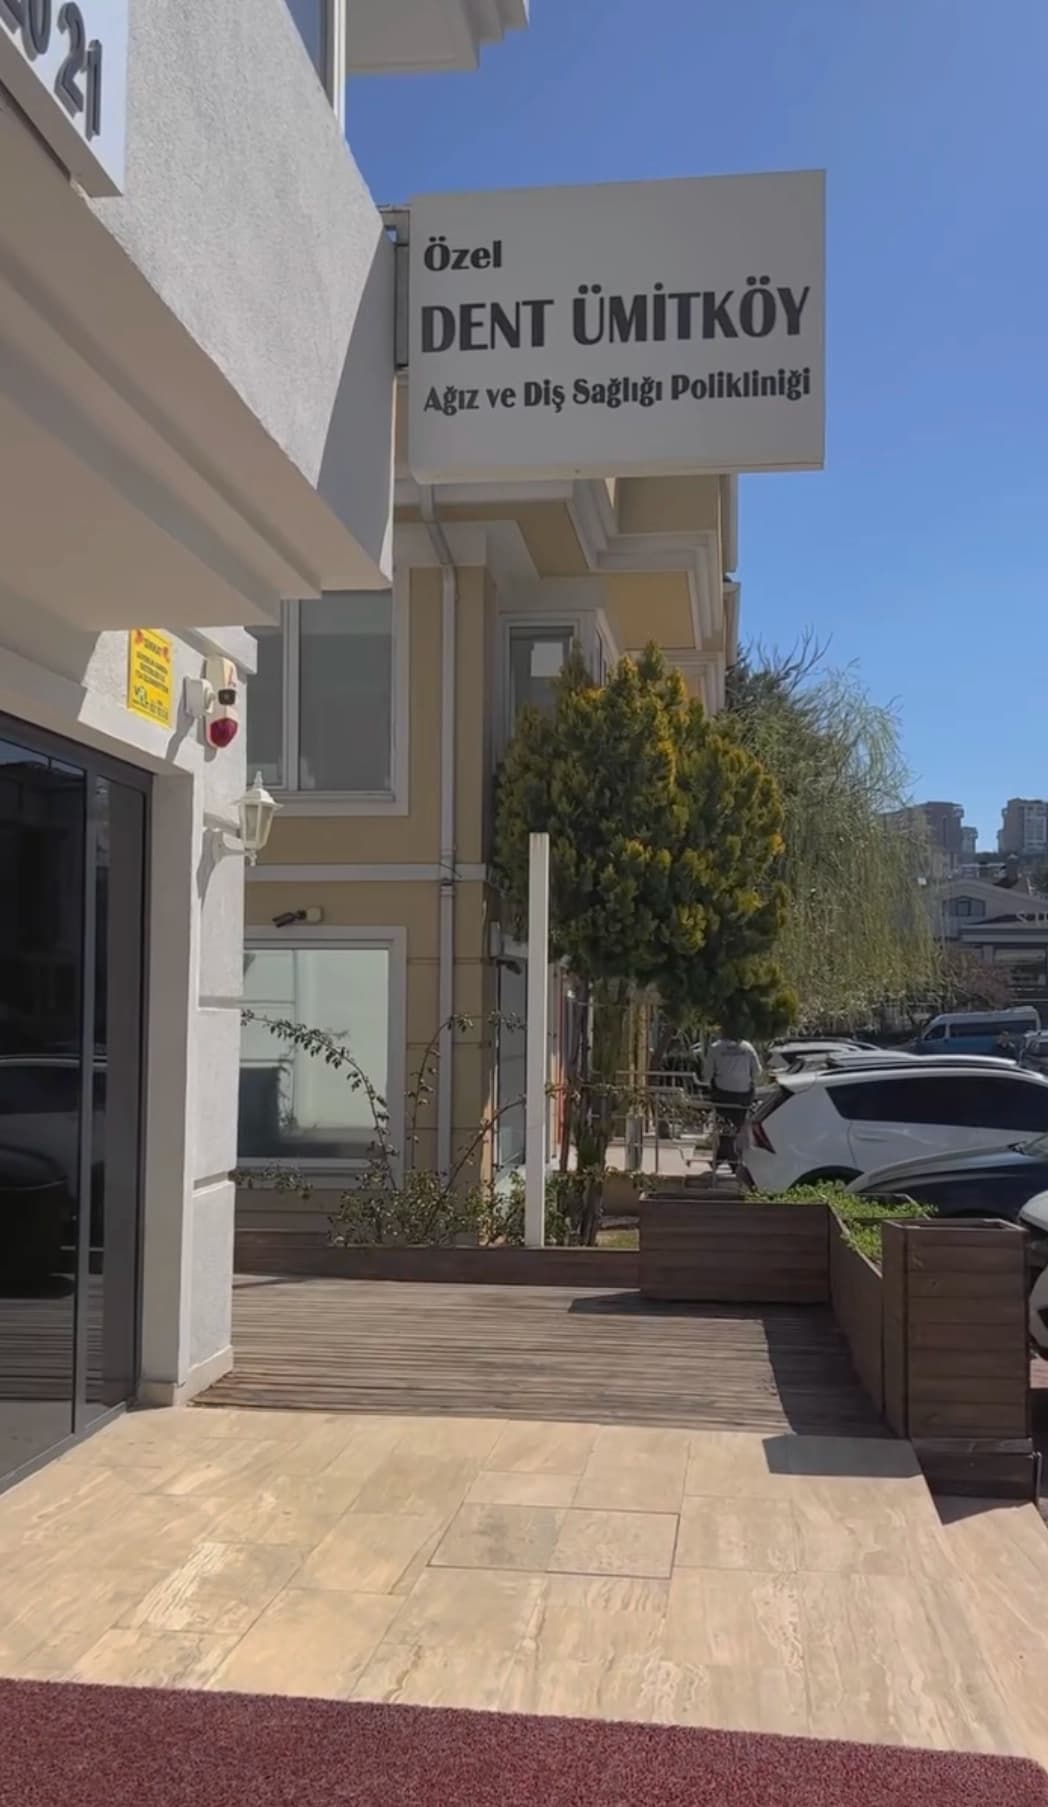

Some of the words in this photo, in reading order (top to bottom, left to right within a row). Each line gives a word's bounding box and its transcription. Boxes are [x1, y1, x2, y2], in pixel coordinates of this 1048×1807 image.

[423, 235, 503, 272] Özel
[421, 299, 555, 354] DENT
[572, 275, 811, 346] ÜMİTKÖY
[423, 385, 480, 417] Ağız
[487, 387, 516, 409] ve
[523, 379, 566, 414] Diş
[572, 376, 663, 409] Sağlığı
[671, 366, 811, 402] Polikliniği
